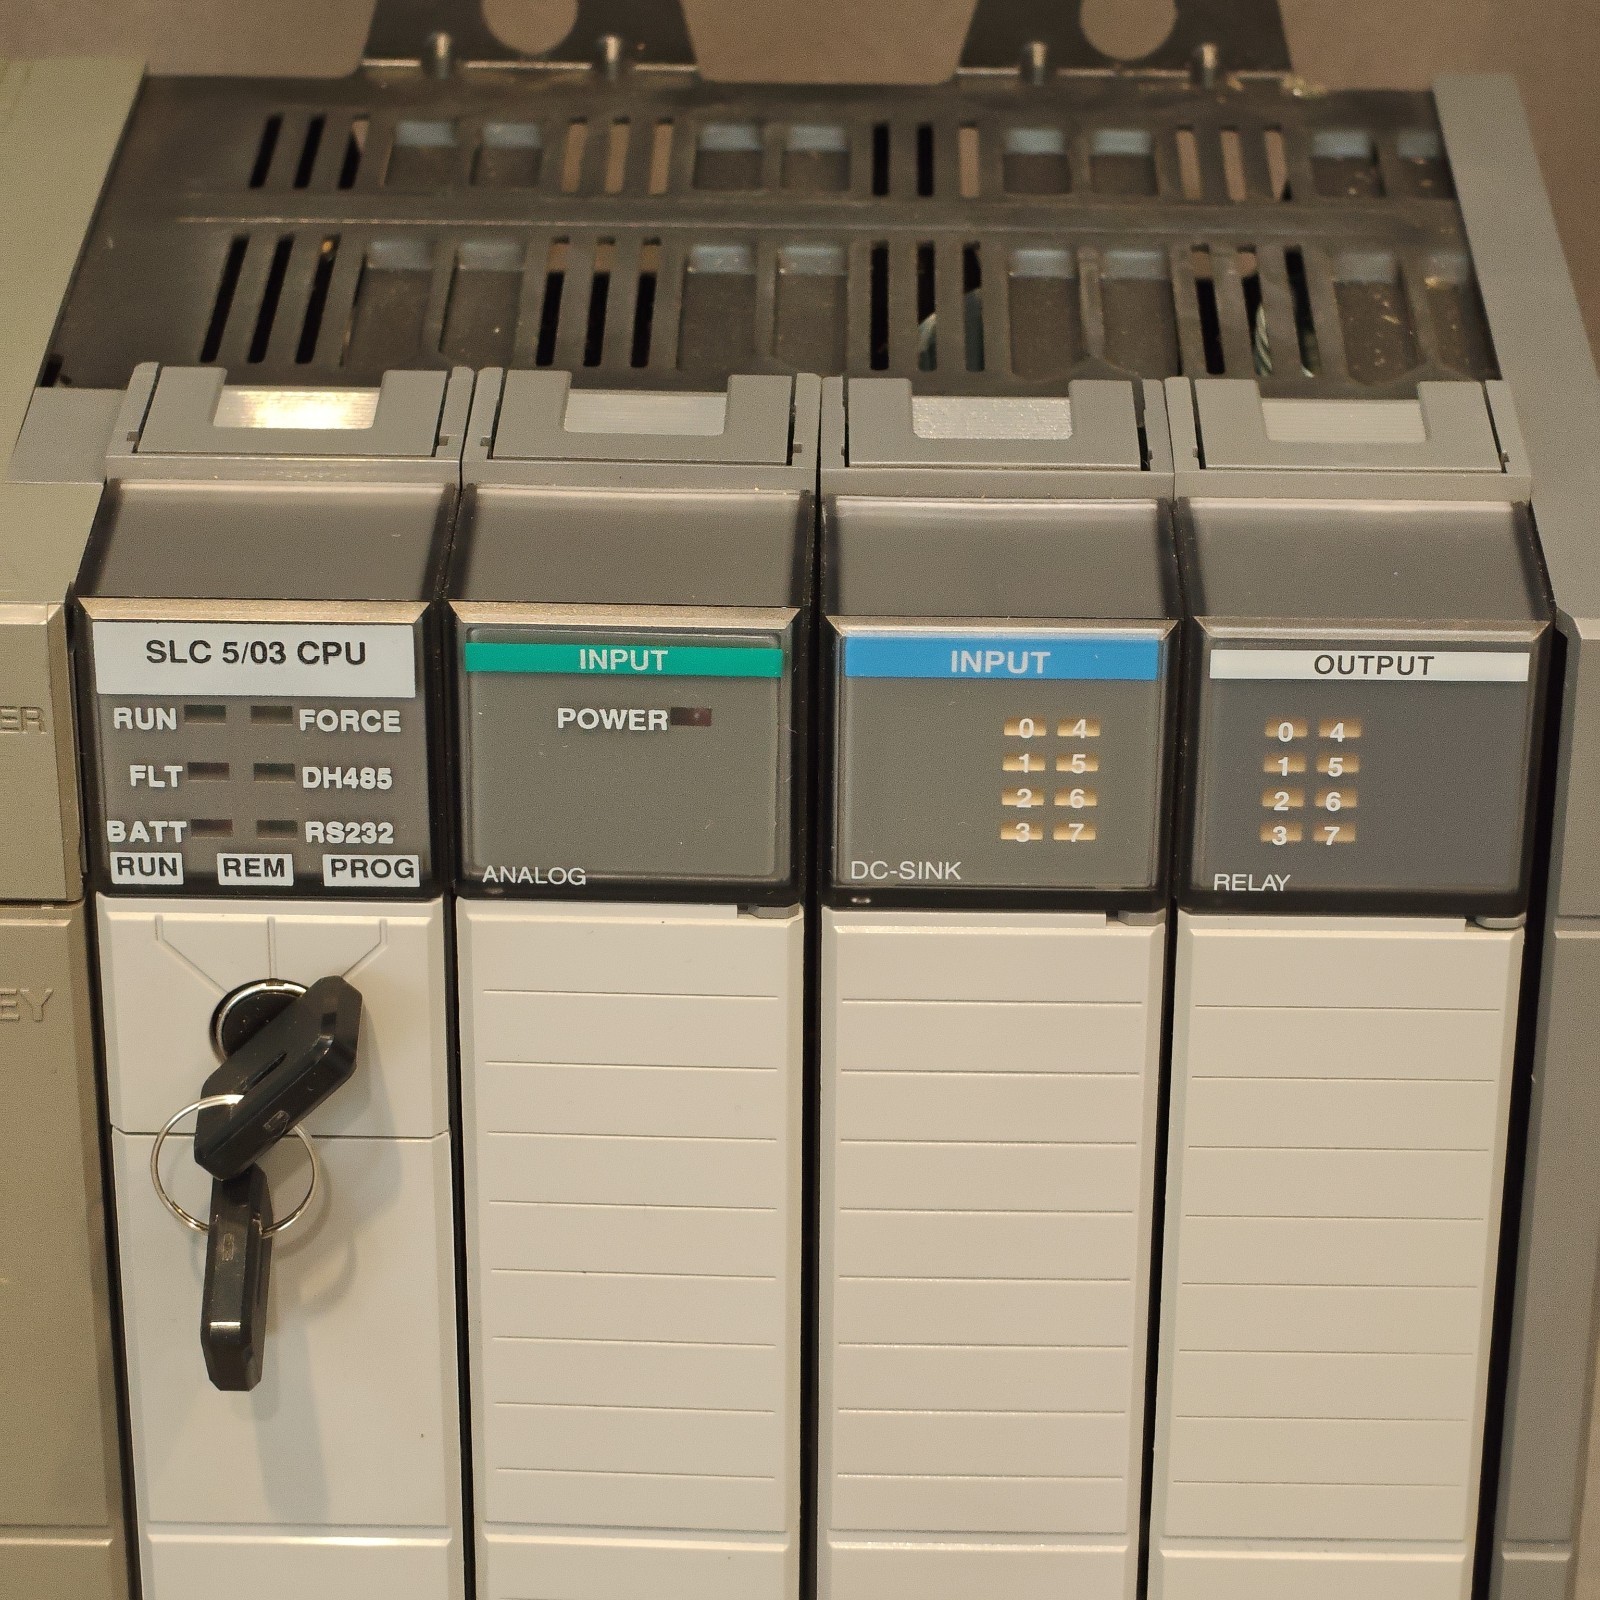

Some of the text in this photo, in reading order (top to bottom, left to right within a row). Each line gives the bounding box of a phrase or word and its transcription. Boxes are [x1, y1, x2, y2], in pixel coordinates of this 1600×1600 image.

[146, 639, 366, 666] SLC 5/03 CPU
[579, 648, 669, 671] INPUT
[950, 649, 1051, 674] INPUT
[1313, 654, 1435, 676] OUTPUT
[113, 707, 177, 730] RUN
[299, 709, 401, 732] FORCE
[557, 707, 668, 731] POWER
[1018, 718, 1087, 739] 0 4
[1277, 722, 1345, 742] 0 4
[1018, 753, 1086, 774] 1 5
[1277, 756, 1343, 777] 1 5
[129, 765, 183, 788] FLT
[302, 766, 393, 790] DH485
[1016, 788, 1085, 809] 2 6
[1273, 791, 1341, 812] 2 6
[106, 820, 187, 843] BATT
[305, 821, 394, 844] RS232
[1015, 822, 1084, 843] 3 7
[1271, 826, 1340, 846] 3 7
[117, 856, 179, 877] RUN
[223, 858, 285, 878] REM
[330, 858, 415, 879] PROG
[482, 865, 587, 886] ANALOG
[850, 860, 962, 881] DC-SINK
[1213, 873, 1291, 892] RELAY
